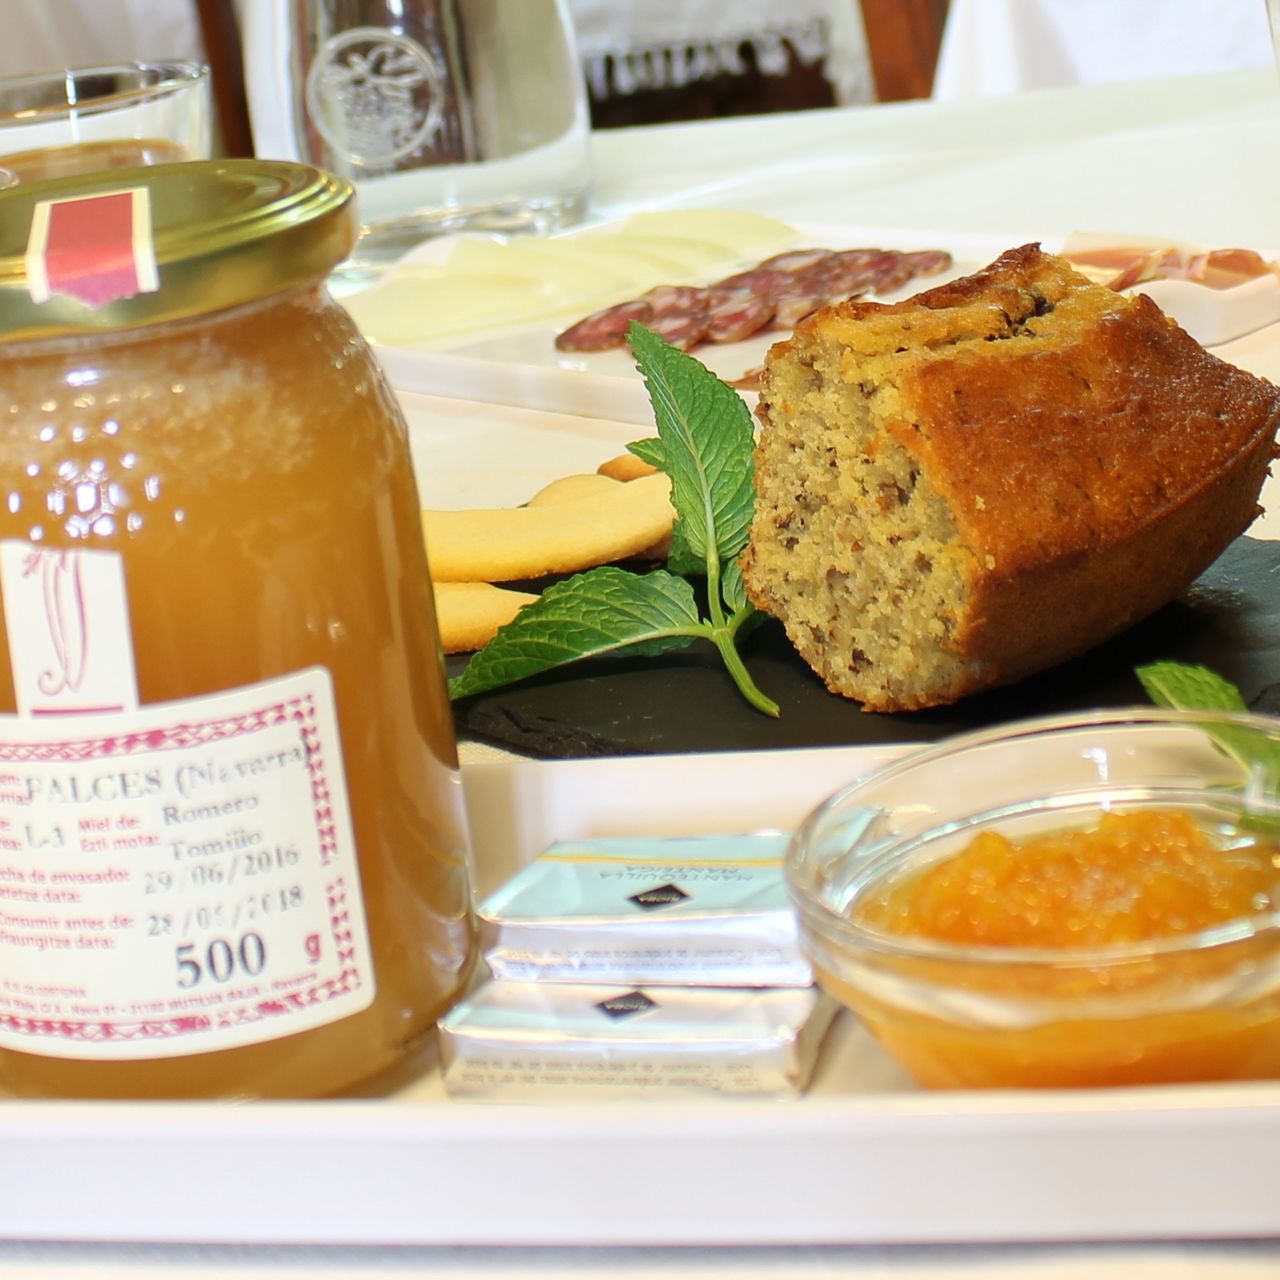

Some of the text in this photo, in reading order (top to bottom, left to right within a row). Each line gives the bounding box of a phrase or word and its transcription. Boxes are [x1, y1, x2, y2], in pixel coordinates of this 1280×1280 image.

[162, 796, 259, 826] Romero
[175, 932, 322, 990] 500 g
